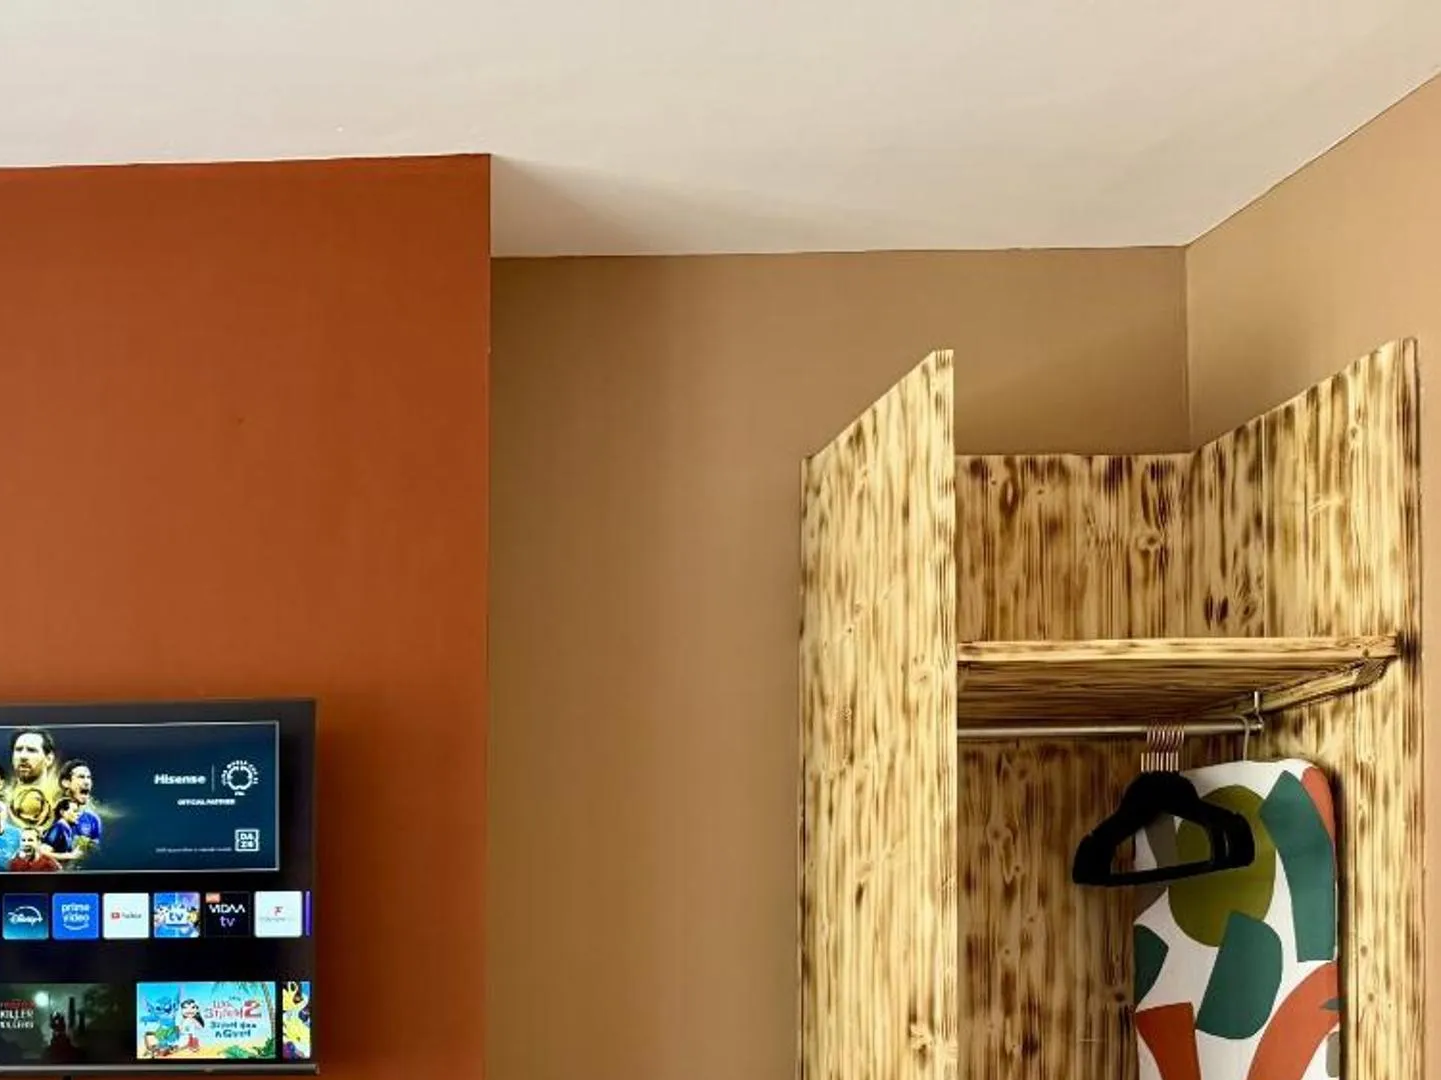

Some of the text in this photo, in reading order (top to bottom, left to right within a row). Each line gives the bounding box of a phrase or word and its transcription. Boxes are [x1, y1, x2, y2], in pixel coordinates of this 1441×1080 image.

[154, 774, 207, 785] Hisense
[220, 916, 236, 927] tv
[244, 1000, 261, 1018] 2
